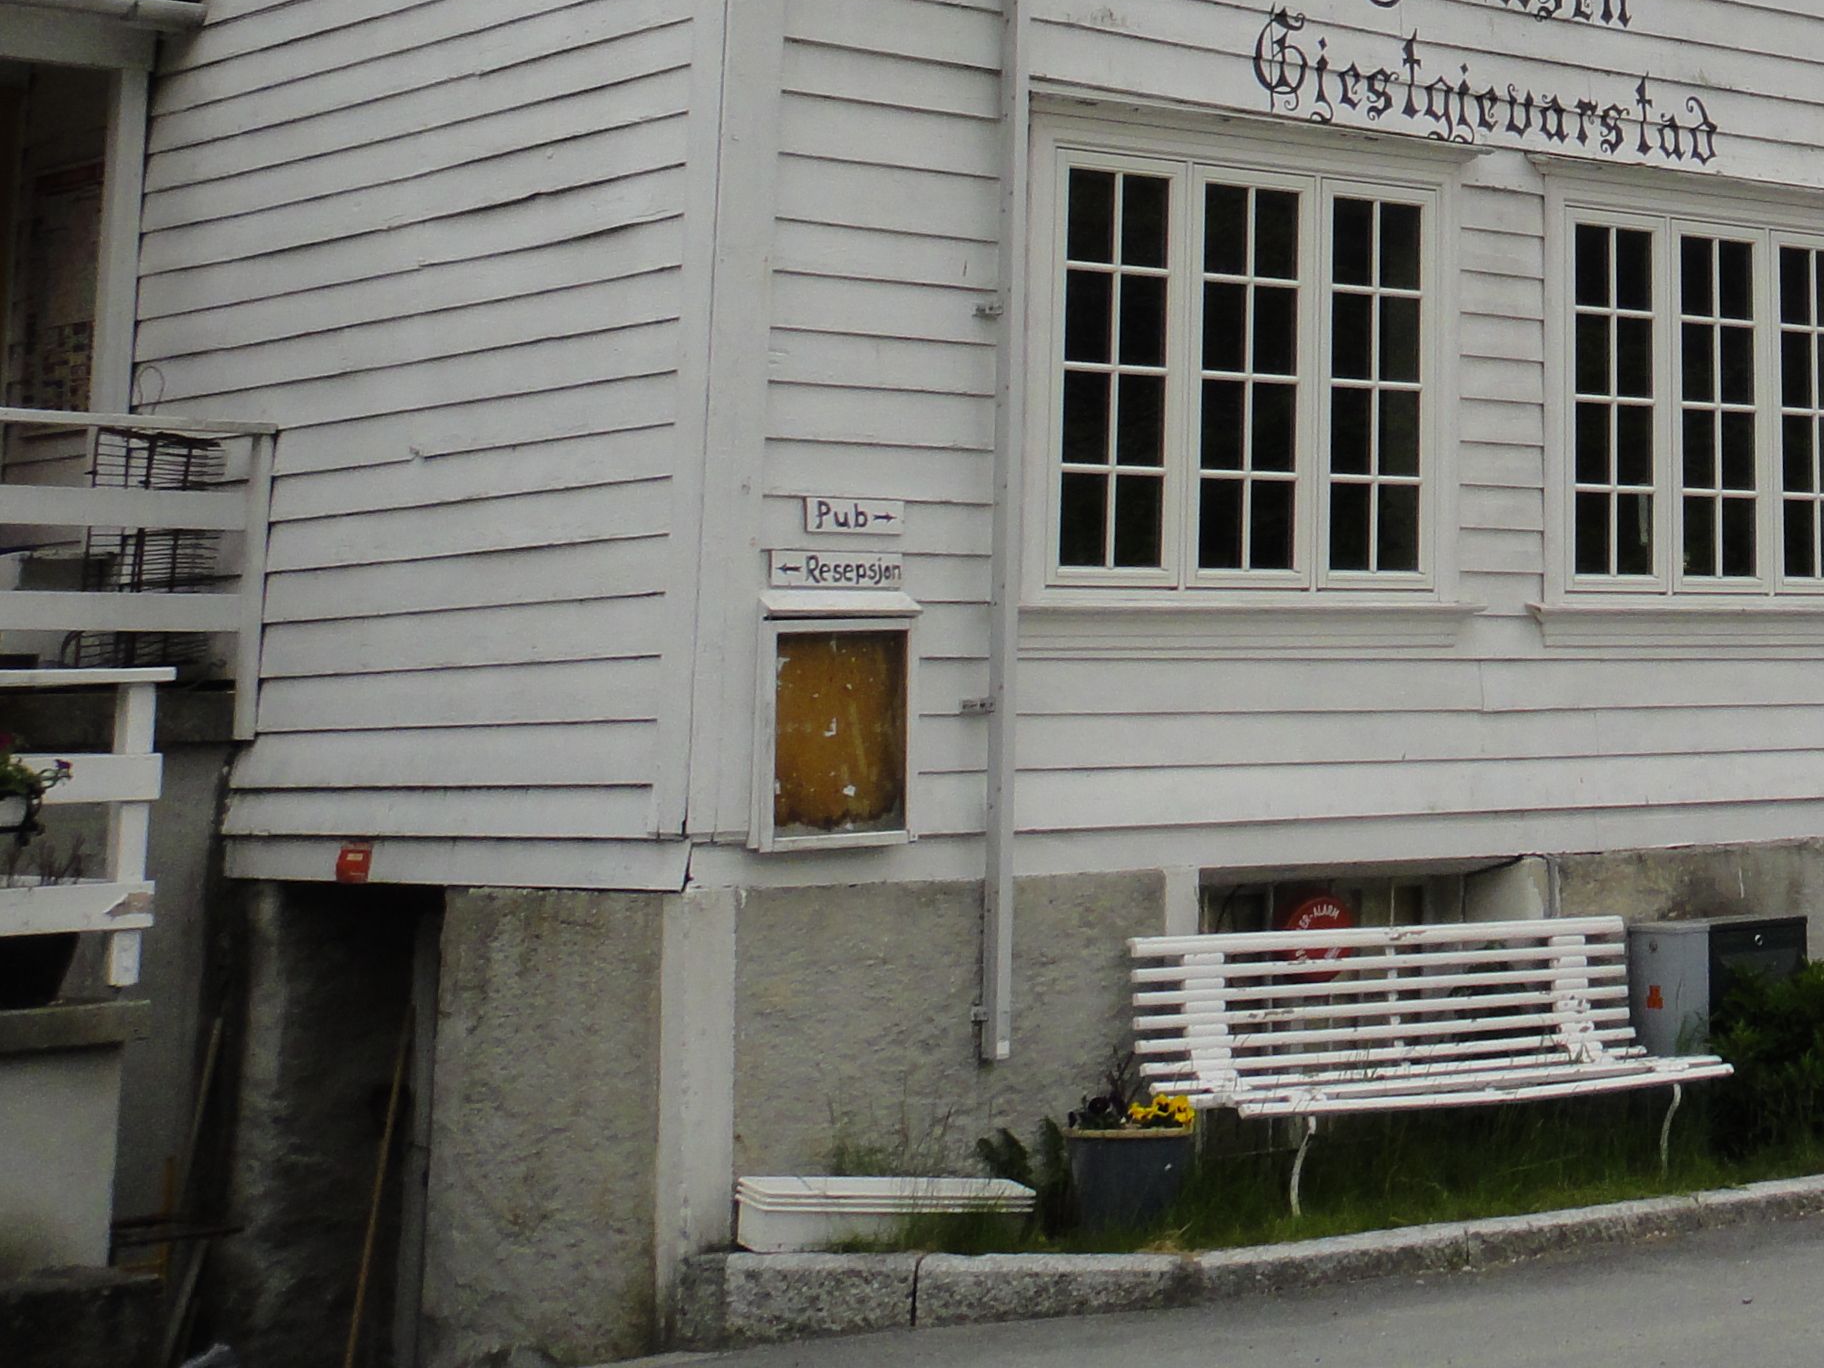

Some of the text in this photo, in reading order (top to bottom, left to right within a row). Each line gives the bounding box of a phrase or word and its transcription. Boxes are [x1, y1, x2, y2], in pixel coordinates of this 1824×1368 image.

[815, 499, 868, 530] Pub
[805, 554, 902, 586] Resepsjon
[1297, 903, 1341, 930] ER-ALARM
